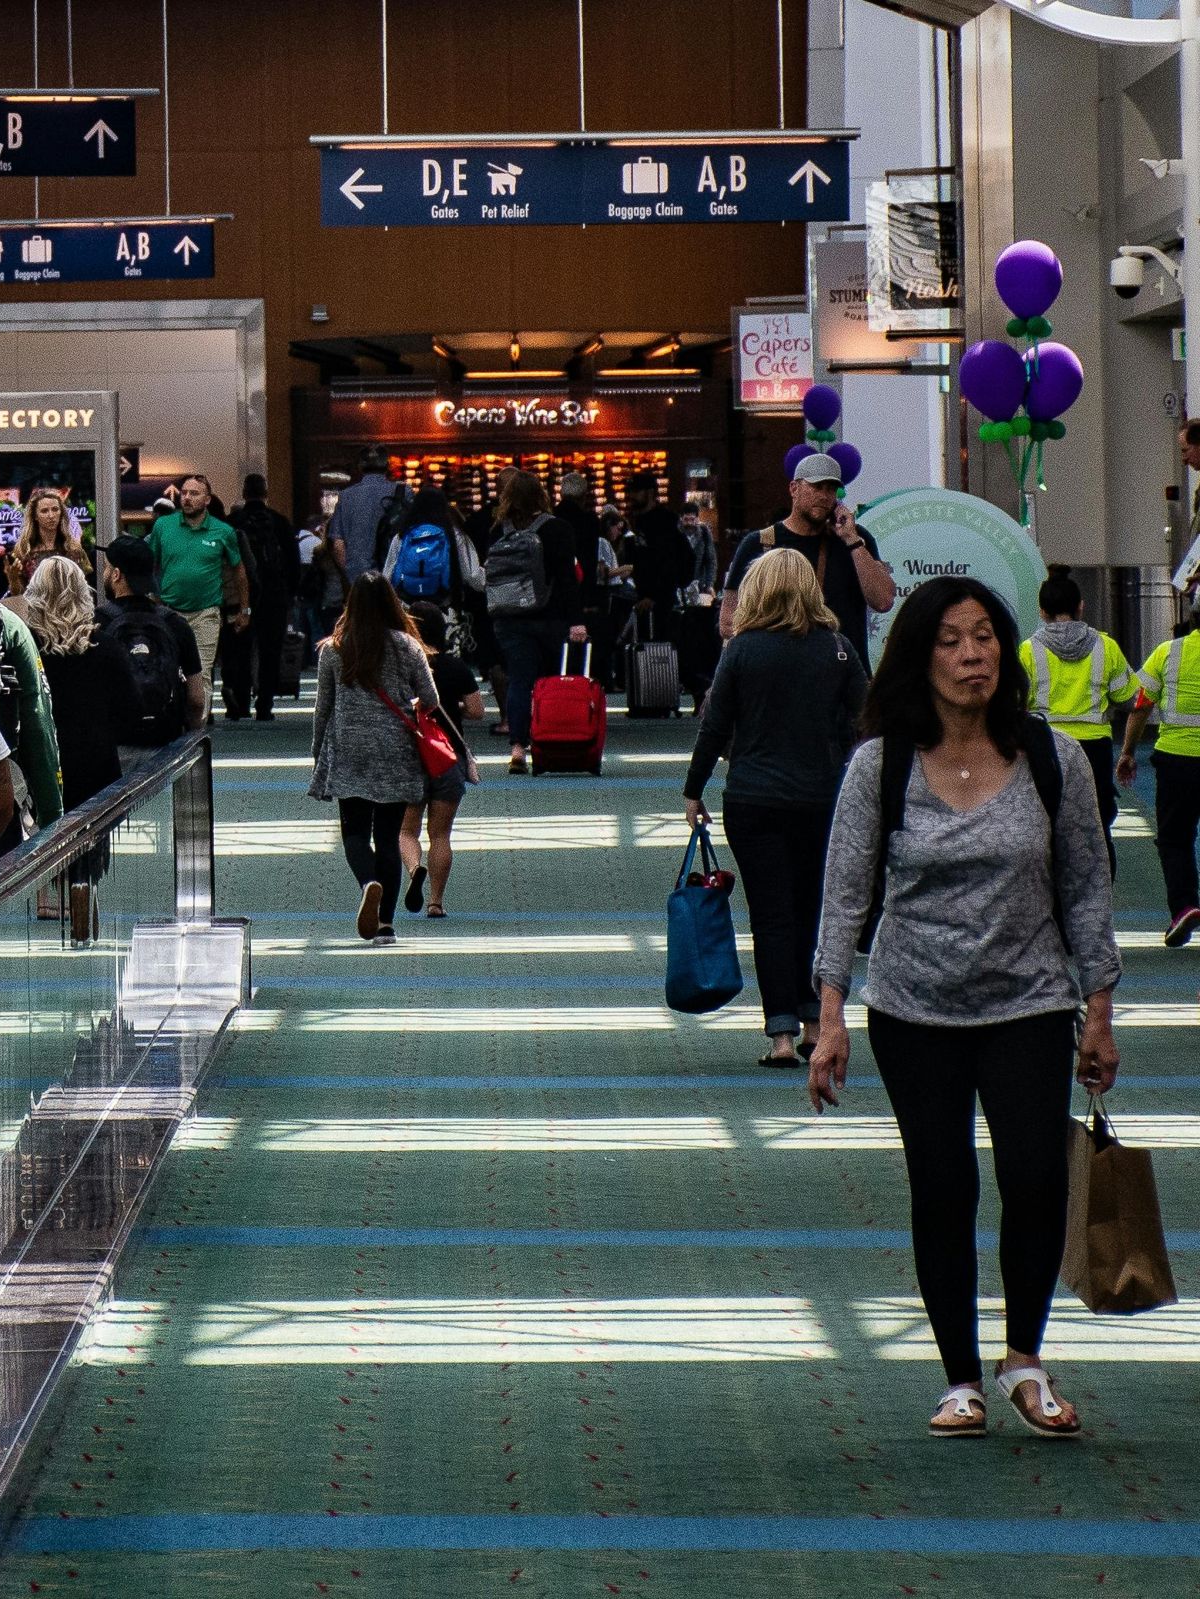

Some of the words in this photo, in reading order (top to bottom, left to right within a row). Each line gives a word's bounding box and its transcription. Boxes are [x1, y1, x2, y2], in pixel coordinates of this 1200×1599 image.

[421, 158, 468, 204] D,E
[696, 154, 748, 201] A,B
[430, 203, 459, 219] Gates
[481, 203, 498, 219] Pet
[500, 202, 530, 219] Relief
[608, 203, 653, 222] Baggage
[654, 201, 684, 218] Claim
[709, 200, 739, 217] Gates
[116, 232, 150, 266] A,B
[14, 269, 42, 281] Baggage
[42, 268, 61, 279] Claim
[124, 265, 143, 277] Gates
[741, 332, 811, 357] Capers
[754, 354, 799, 377] Café
[434, 400, 506, 428] Capers
[507, 398, 558, 427] Wine
[560, 400, 600, 426] Bar
[875, 505, 955, 533] LAMETTE
[965, 510, 1019, 555] VALLEY
[903, 558, 971, 576] Wander
